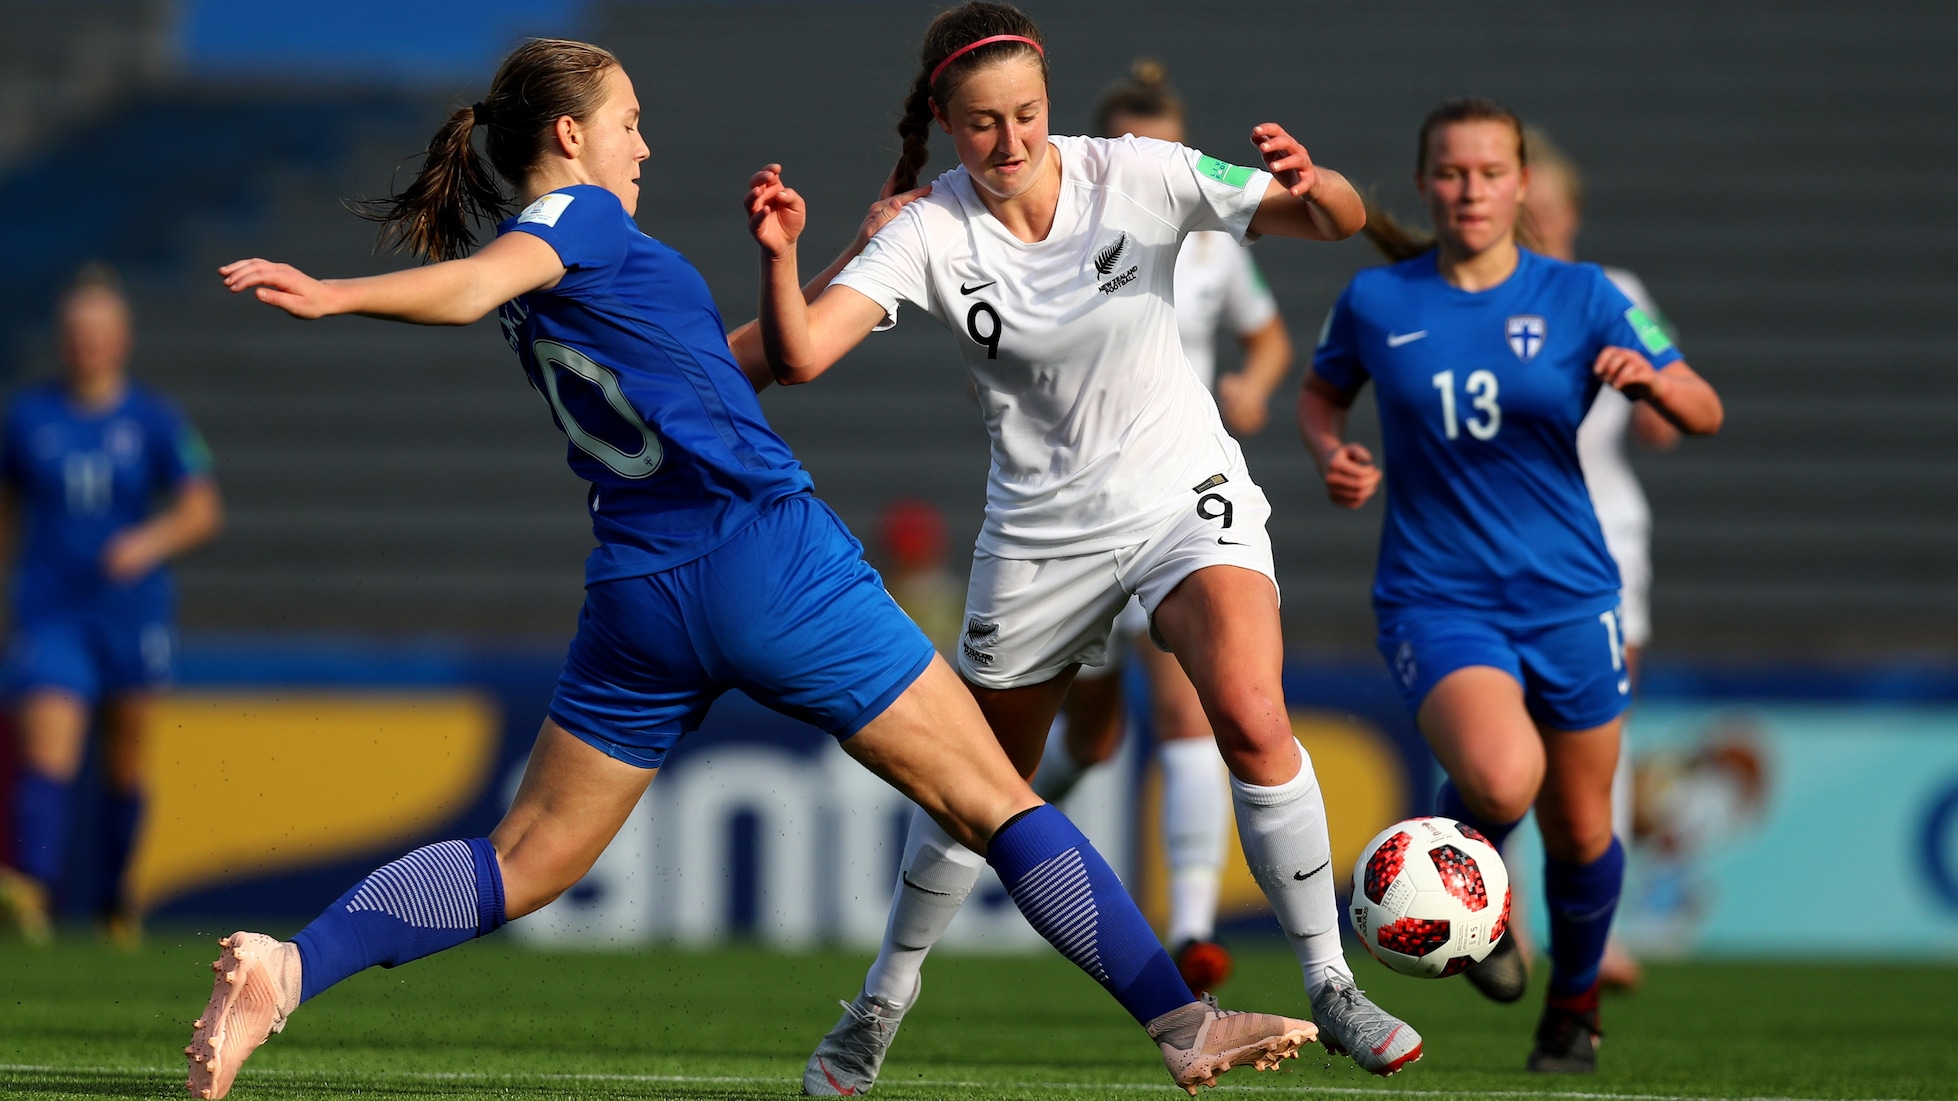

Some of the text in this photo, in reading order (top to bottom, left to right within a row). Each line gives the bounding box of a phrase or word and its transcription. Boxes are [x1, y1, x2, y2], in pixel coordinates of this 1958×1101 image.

[1099, 266, 1138, 293] NEW ZEALAND
[1105, 274, 1136, 295] FOOTBALL
[967, 302, 1002, 360] 9
[528, 338, 664, 479] 0
[1432, 369, 1501, 440] 13
[1197, 493, 1233, 529] 9
[1382, 879, 1402, 909] TELSTAR
